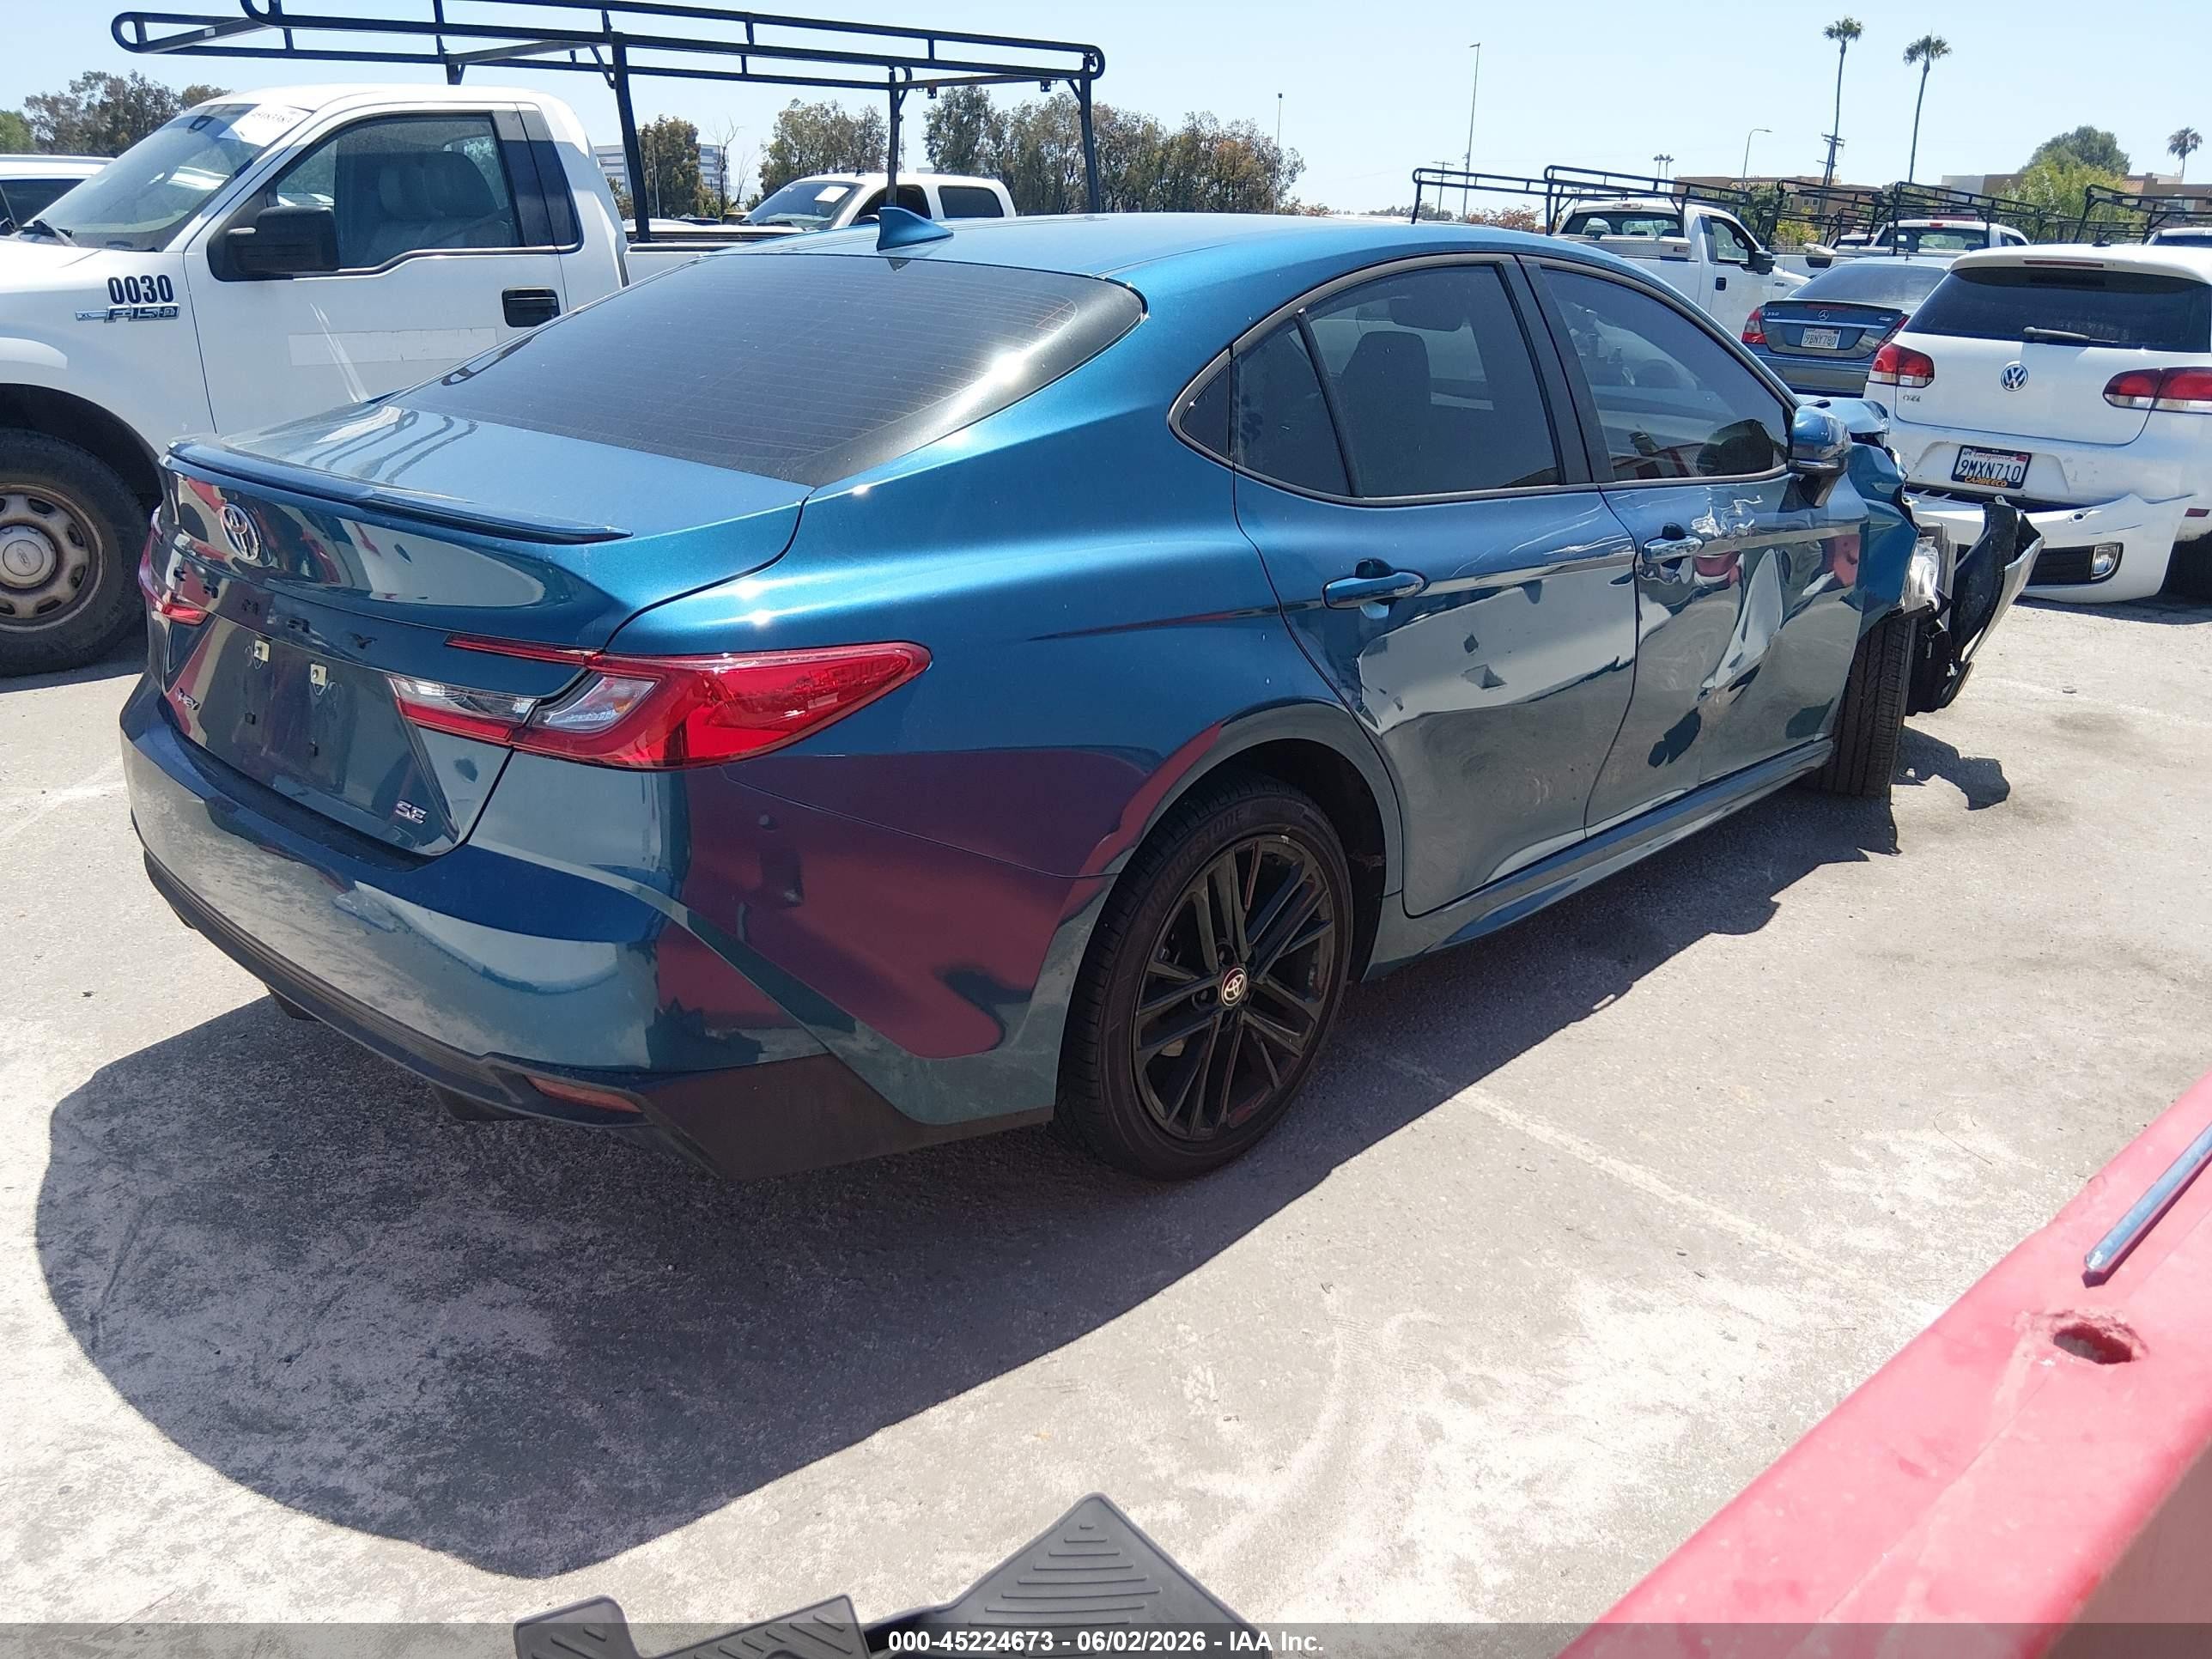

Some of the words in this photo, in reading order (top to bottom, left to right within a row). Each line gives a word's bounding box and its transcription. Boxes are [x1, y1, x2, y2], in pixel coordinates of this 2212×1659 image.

[107, 275, 174, 304] 0030
[1957, 459, 2021, 482] 9MXN710
[1964, 476, 2008, 488] CARBEECO
[395, 799, 428, 824] SE
